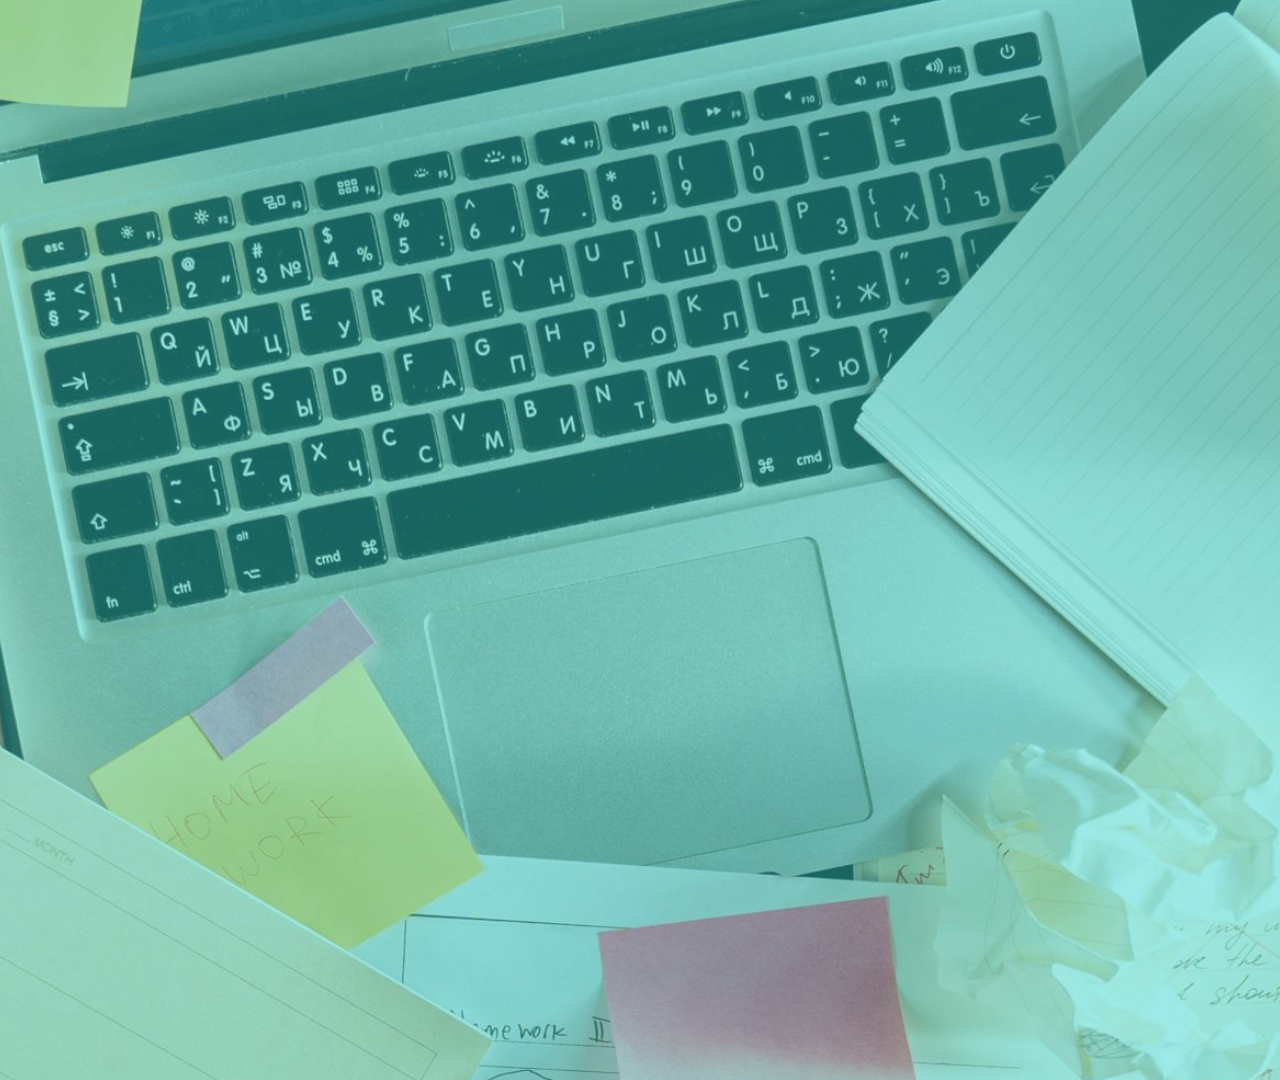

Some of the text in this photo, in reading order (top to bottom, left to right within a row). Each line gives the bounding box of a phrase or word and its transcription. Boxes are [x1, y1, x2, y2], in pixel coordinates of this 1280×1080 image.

[583, 64, 962, 150] F7 F8 F9 F10 F11 F12
[145, 153, 523, 240] F1 F2 F3 F4 F5 F6
[43, 241, 65, 254] esc
[159, 200, 809, 351] Q W E R T Y U I O P
[796, 449, 823, 467] cmd
[235, 530, 250, 542] alt
[314, 549, 342, 567] cmd
[172, 579, 193, 595] ctrl
[105, 595, 120, 609] fn
[149, 762, 277, 848] HOME
[34, 838, 75, 865] MONTH
[221, 796, 352, 886] WORK
